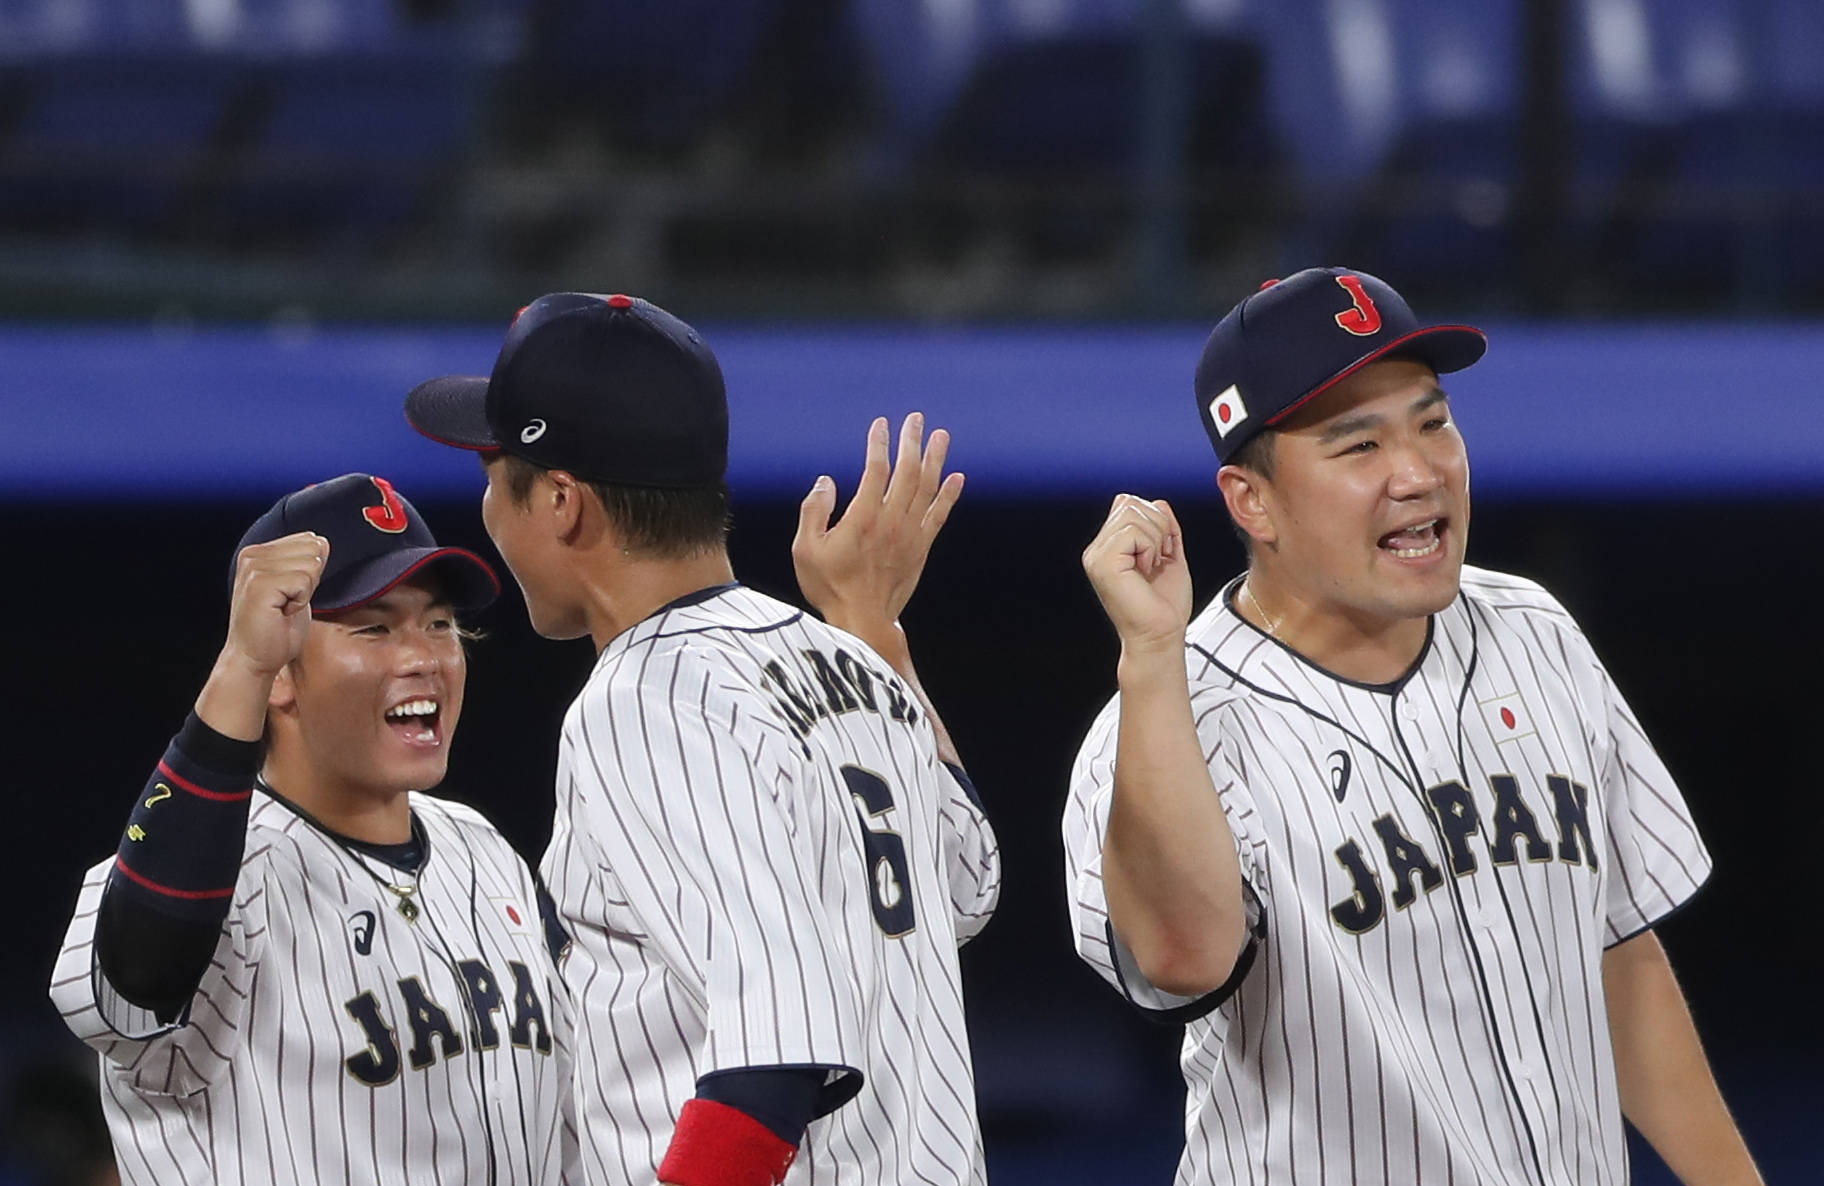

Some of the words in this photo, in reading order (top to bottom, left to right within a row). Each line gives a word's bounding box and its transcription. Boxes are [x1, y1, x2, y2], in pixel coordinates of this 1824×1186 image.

[1335, 275, 1382, 336] J
[362, 476, 408, 533] J
[840, 763, 917, 940] 6
[1329, 773, 1599, 936] JAPAN
[344, 958, 553, 1088] JAPA
